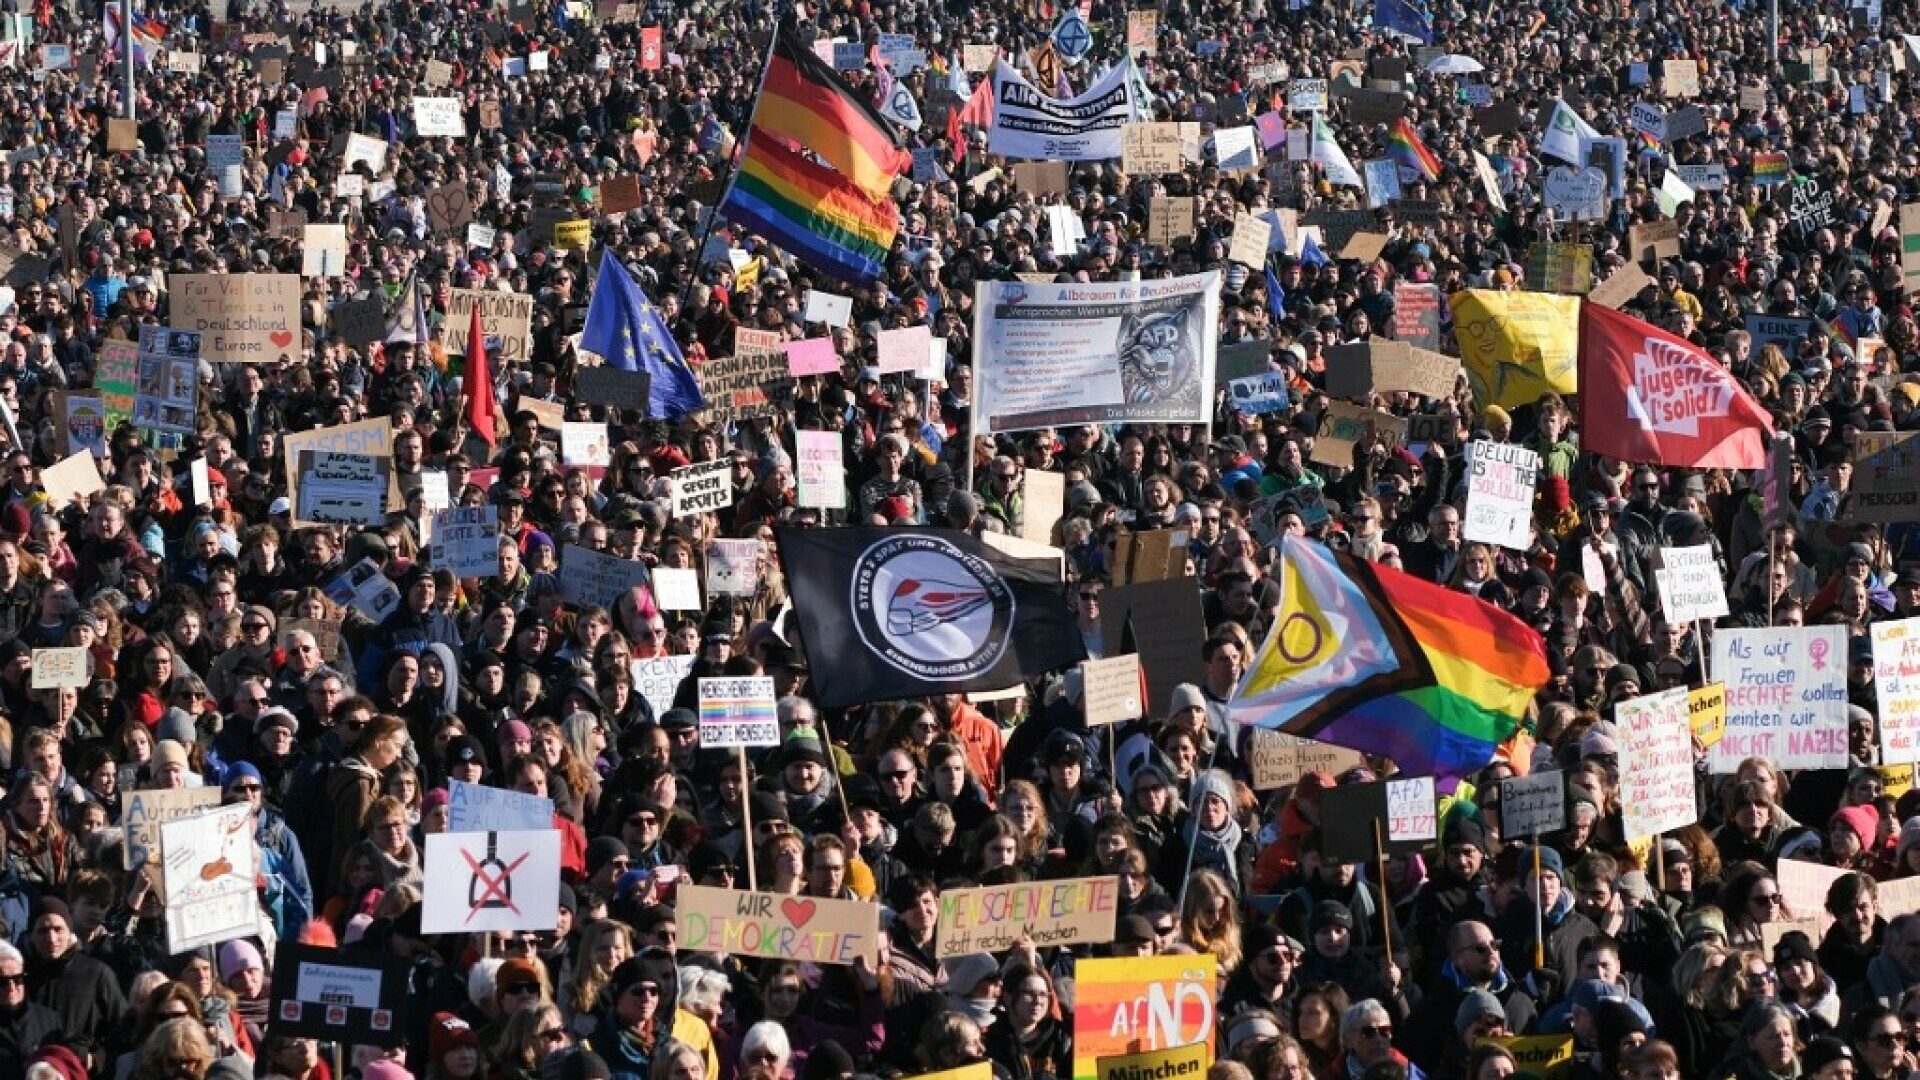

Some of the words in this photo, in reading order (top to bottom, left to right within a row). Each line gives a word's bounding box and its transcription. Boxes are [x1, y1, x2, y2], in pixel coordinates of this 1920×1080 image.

[1633, 107, 1662, 126] STOP
[185, 279, 209, 296] Für
[273, 302, 284, 312] in
[1142, 324, 1178, 344] AFD
[1758, 321, 1799, 336] KEINE
[215, 337, 262, 352] Europa
[1475, 442, 1534, 469] DELULU
[1473, 461, 1485, 477] IS
[1515, 466, 1536, 487] THE
[682, 476, 720, 494] GEGEN
[680, 489, 728, 511] RECHTS
[1728, 637, 1751, 659] Als
[1763, 637, 1792, 657] wir
[1739, 667, 1795, 685] Frauen
[1725, 684, 1797, 707] RECHTE
[1790, 707, 1816, 727] wir
[1719, 732, 1775, 757] NICHT
[1788, 728, 1848, 756] NAZIS
[451, 782, 497, 806] AUF
[1389, 778, 1425, 803] AfD
[1393, 816, 1437, 834] JETZT
[737, 894, 774, 918] WIR
[941, 879, 1115, 929] MENSCHENRECHTE
[685, 913, 862, 961] DEMOKRATIE
[945, 931, 972, 955] statt
[976, 926, 1013, 948] rechte
[1022, 920, 1078, 942] Menschen
[1515, 1044, 1563, 1064] nchen
[1109, 1059, 1200, 1080] München
